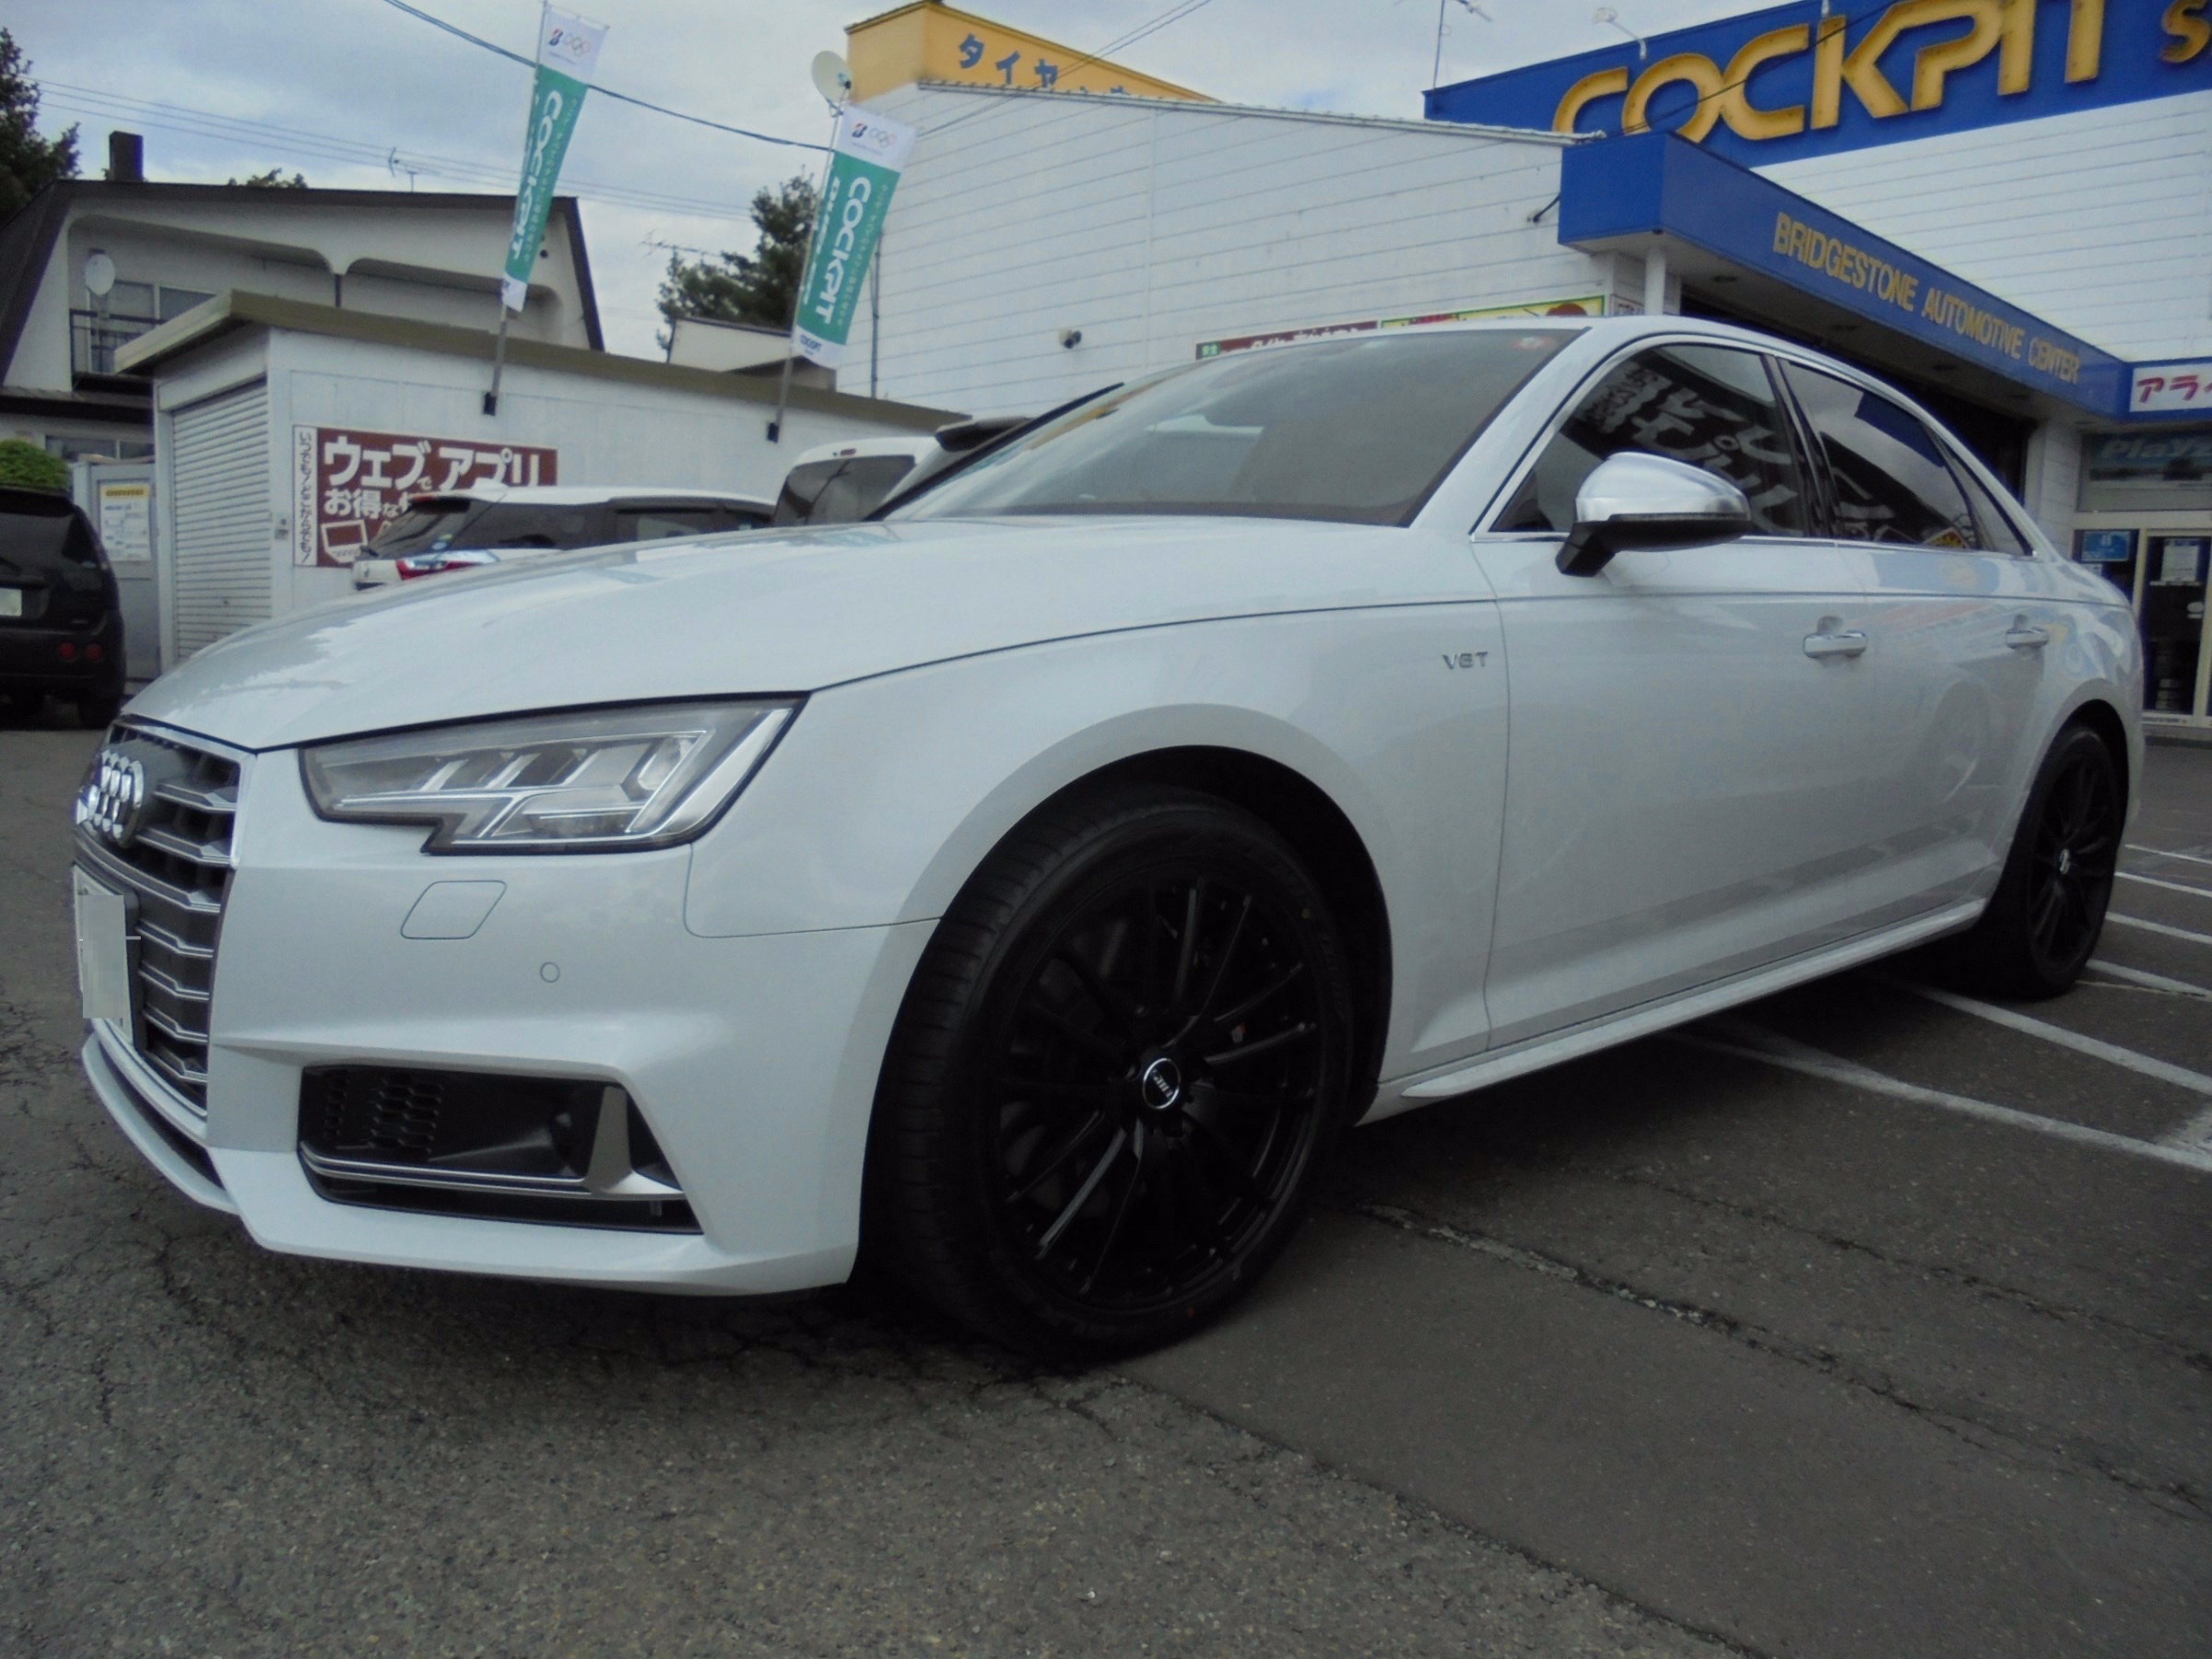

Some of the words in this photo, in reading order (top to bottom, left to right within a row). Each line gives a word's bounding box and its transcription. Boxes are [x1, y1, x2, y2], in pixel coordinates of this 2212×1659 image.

[815, 176, 872, 324] COCKPIT
[1772, 211, 1918, 312] BRIDGESTONE
[1921, 287, 2025, 360] AUTOMOTIVE
[2029, 337, 2080, 383] CENTER
[2136, 374, 2212, 404] アラ
